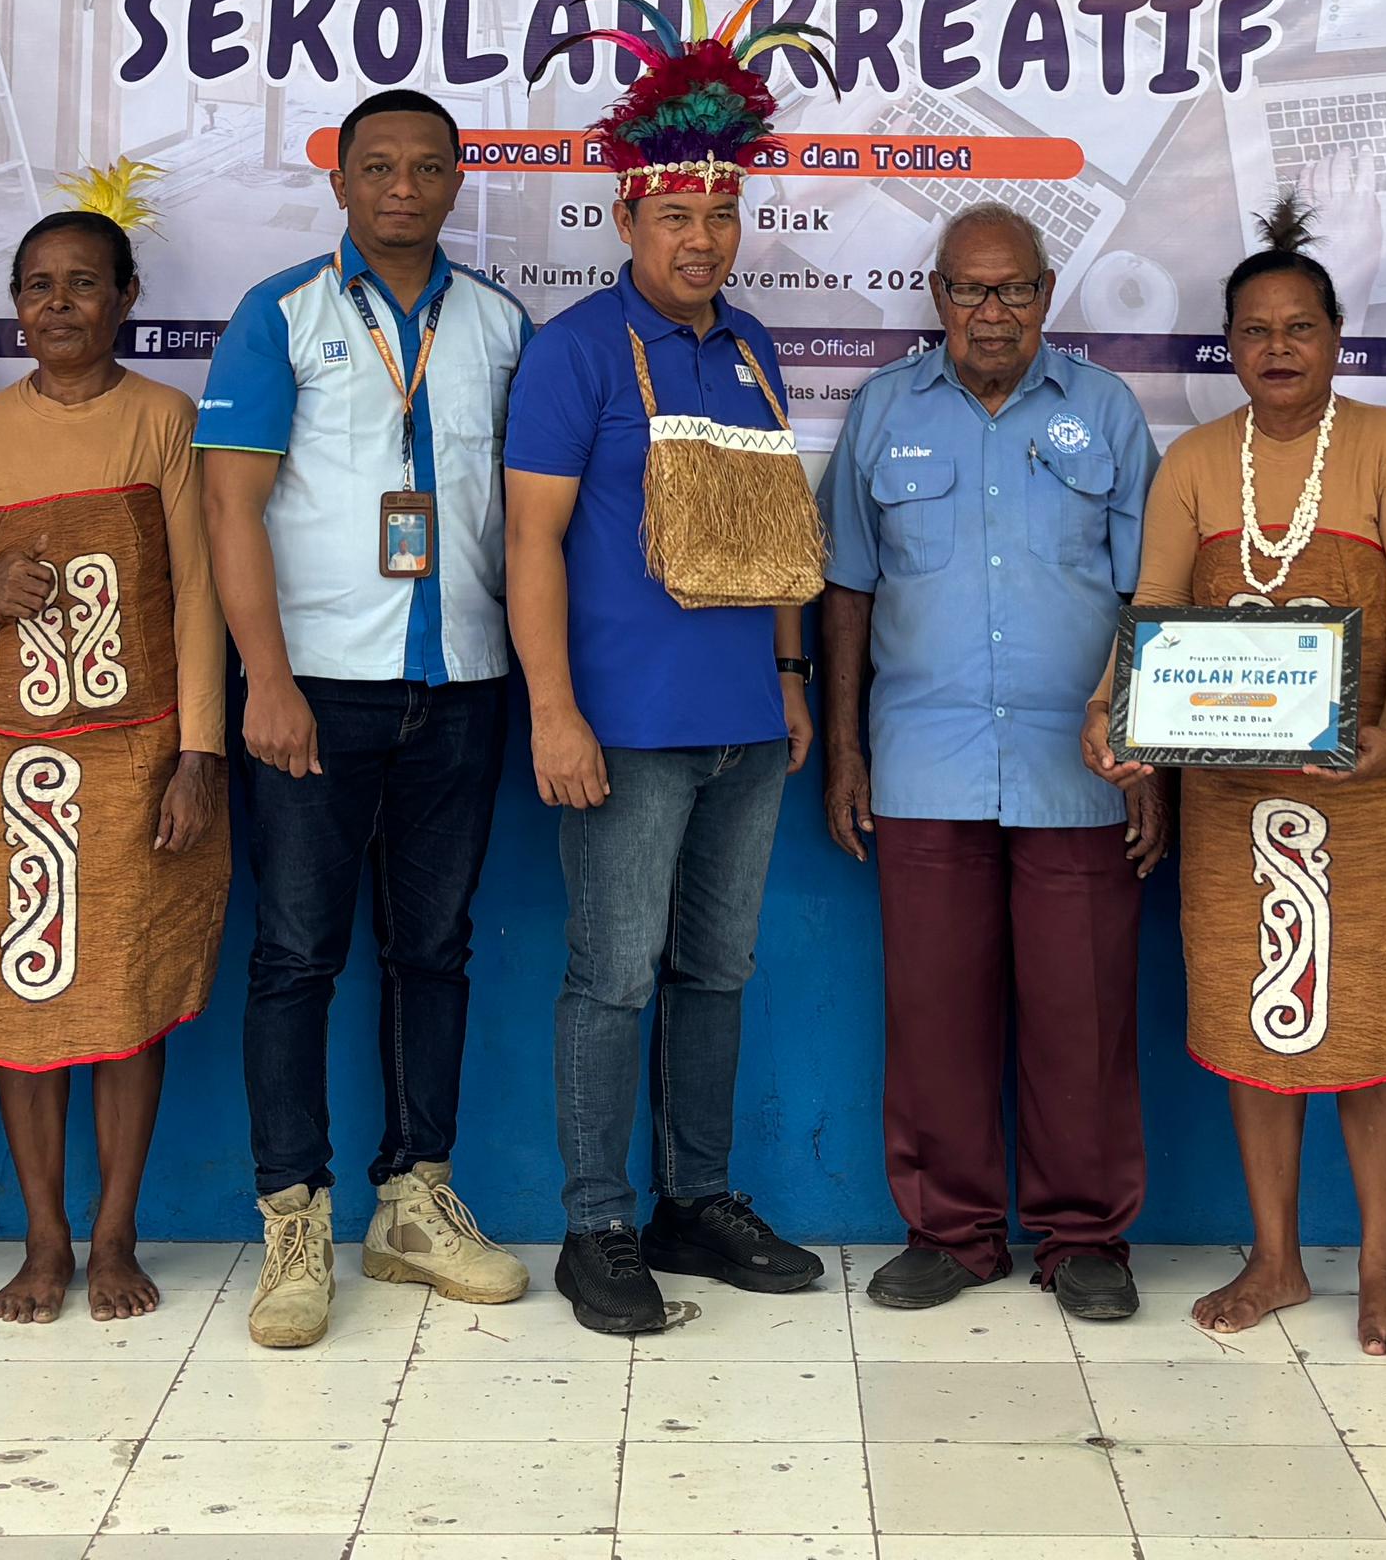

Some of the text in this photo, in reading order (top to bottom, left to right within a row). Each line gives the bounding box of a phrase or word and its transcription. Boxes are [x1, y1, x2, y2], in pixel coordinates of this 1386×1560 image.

[463, 141, 570, 164] novasi
[803, 143, 859, 167] dan
[874, 145, 971, 169] Toilet
[561, 205, 830, 231] SD Biak
[521, 265, 614, 286] Numfo
[725, 268, 854, 289] ovember
[868, 270, 926, 291] 202
[324, 342, 347, 357] BFI
[811, 339, 875, 357] Official
[1189, 655, 1221, 663] Program
[1152, 668, 1318, 686] SEKOLAH KREATIF
[1191, 714, 1205, 722] SD
[1250, 715, 1273, 723] Biak
